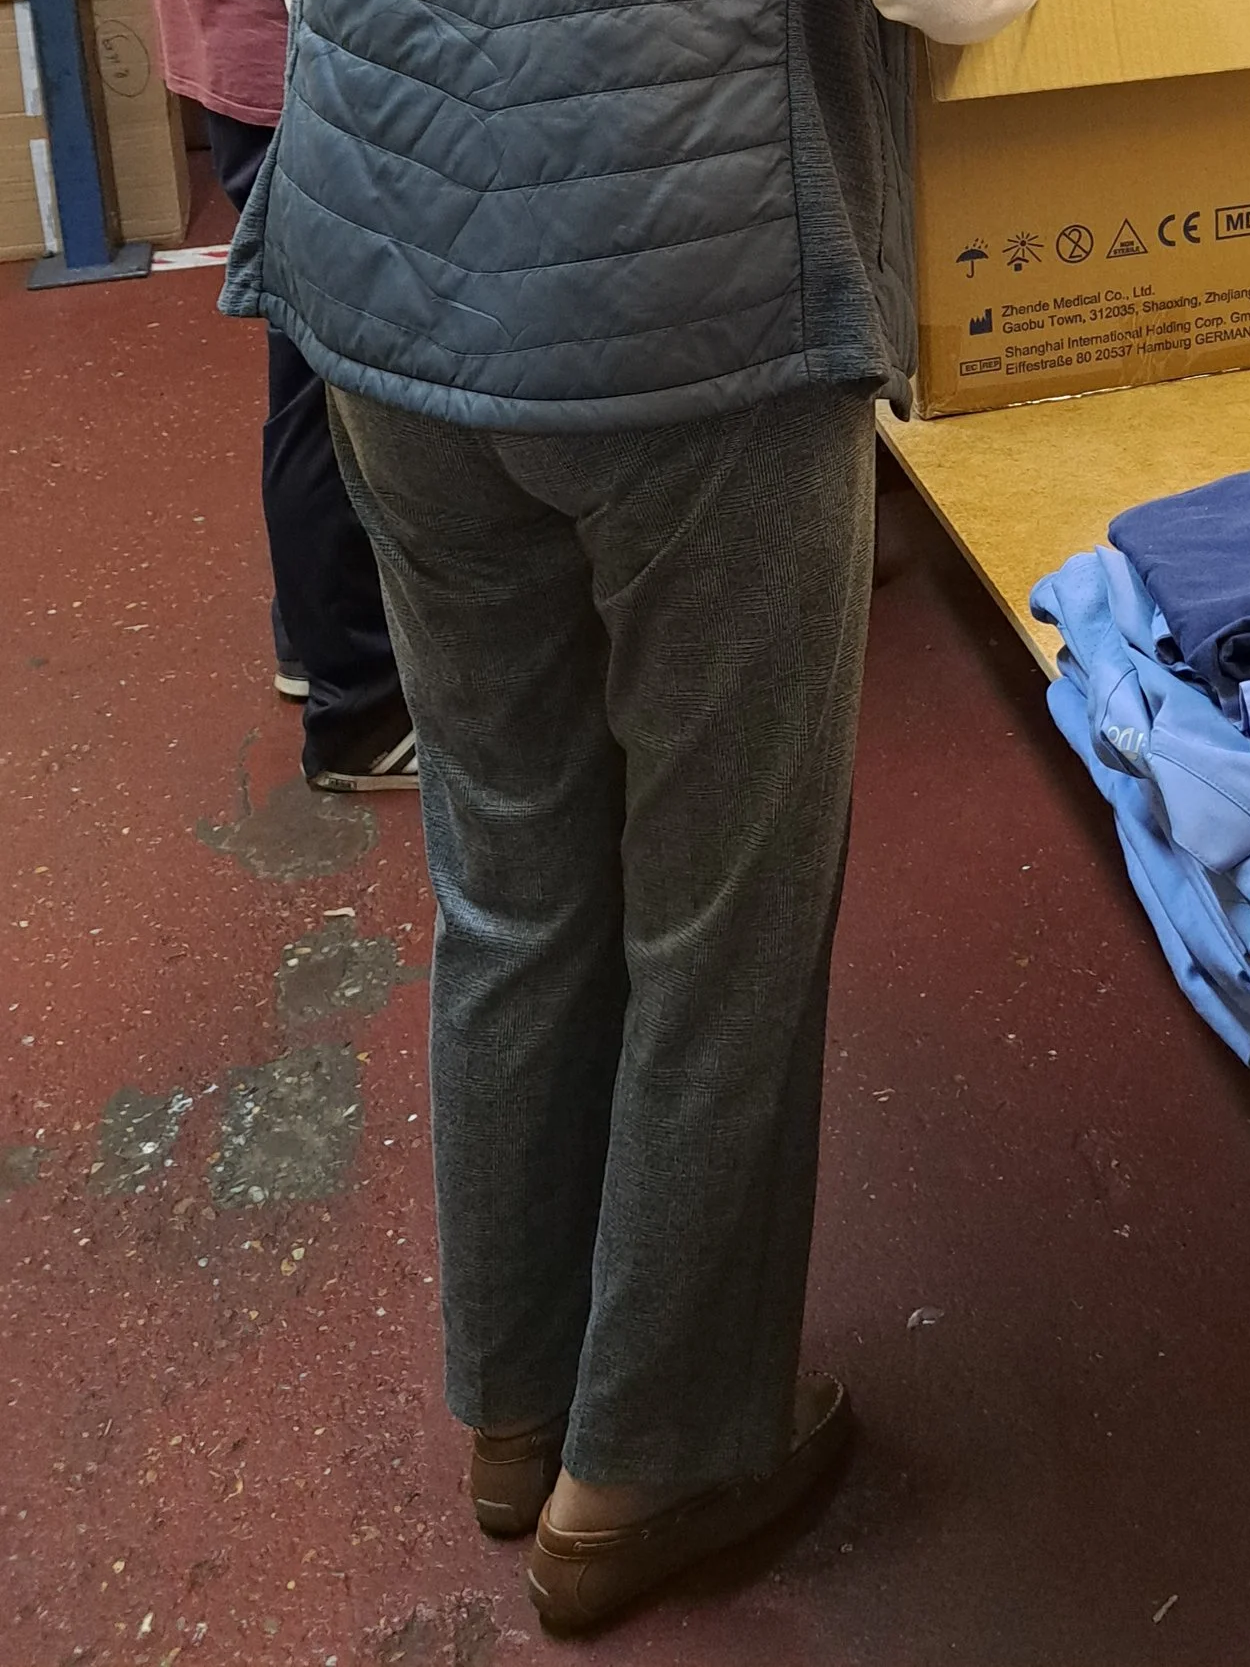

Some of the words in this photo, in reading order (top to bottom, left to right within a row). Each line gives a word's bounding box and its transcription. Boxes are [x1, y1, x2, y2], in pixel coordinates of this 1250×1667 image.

[1001, 299, 1050, 318] Zhende
[1053, 292, 1101, 310] Medical
[1132, 284, 1156, 299] Ltd.
[1002, 318, 1045, 334] Gaobu
[1048, 313, 1087, 328] Town,
[1089, 303, 1139, 322] 312035,
[1142, 295, 1202, 314] Shaoxing,
[1004, 339, 1065, 359] Shanghai
[1067, 326, 1143, 349] International
[1145, 319, 1192, 336] Holding
[1194, 315, 1227, 330] Corp.
[1005, 354, 1073, 376] Eiffestraße
[1076, 350, 1093, 364] 80
[1094, 344, 1134, 363] 20537
[1136, 335, 1192, 356] Hamburg
[964, 359, 979, 372] EC
[982, 359, 1001, 370] REP
